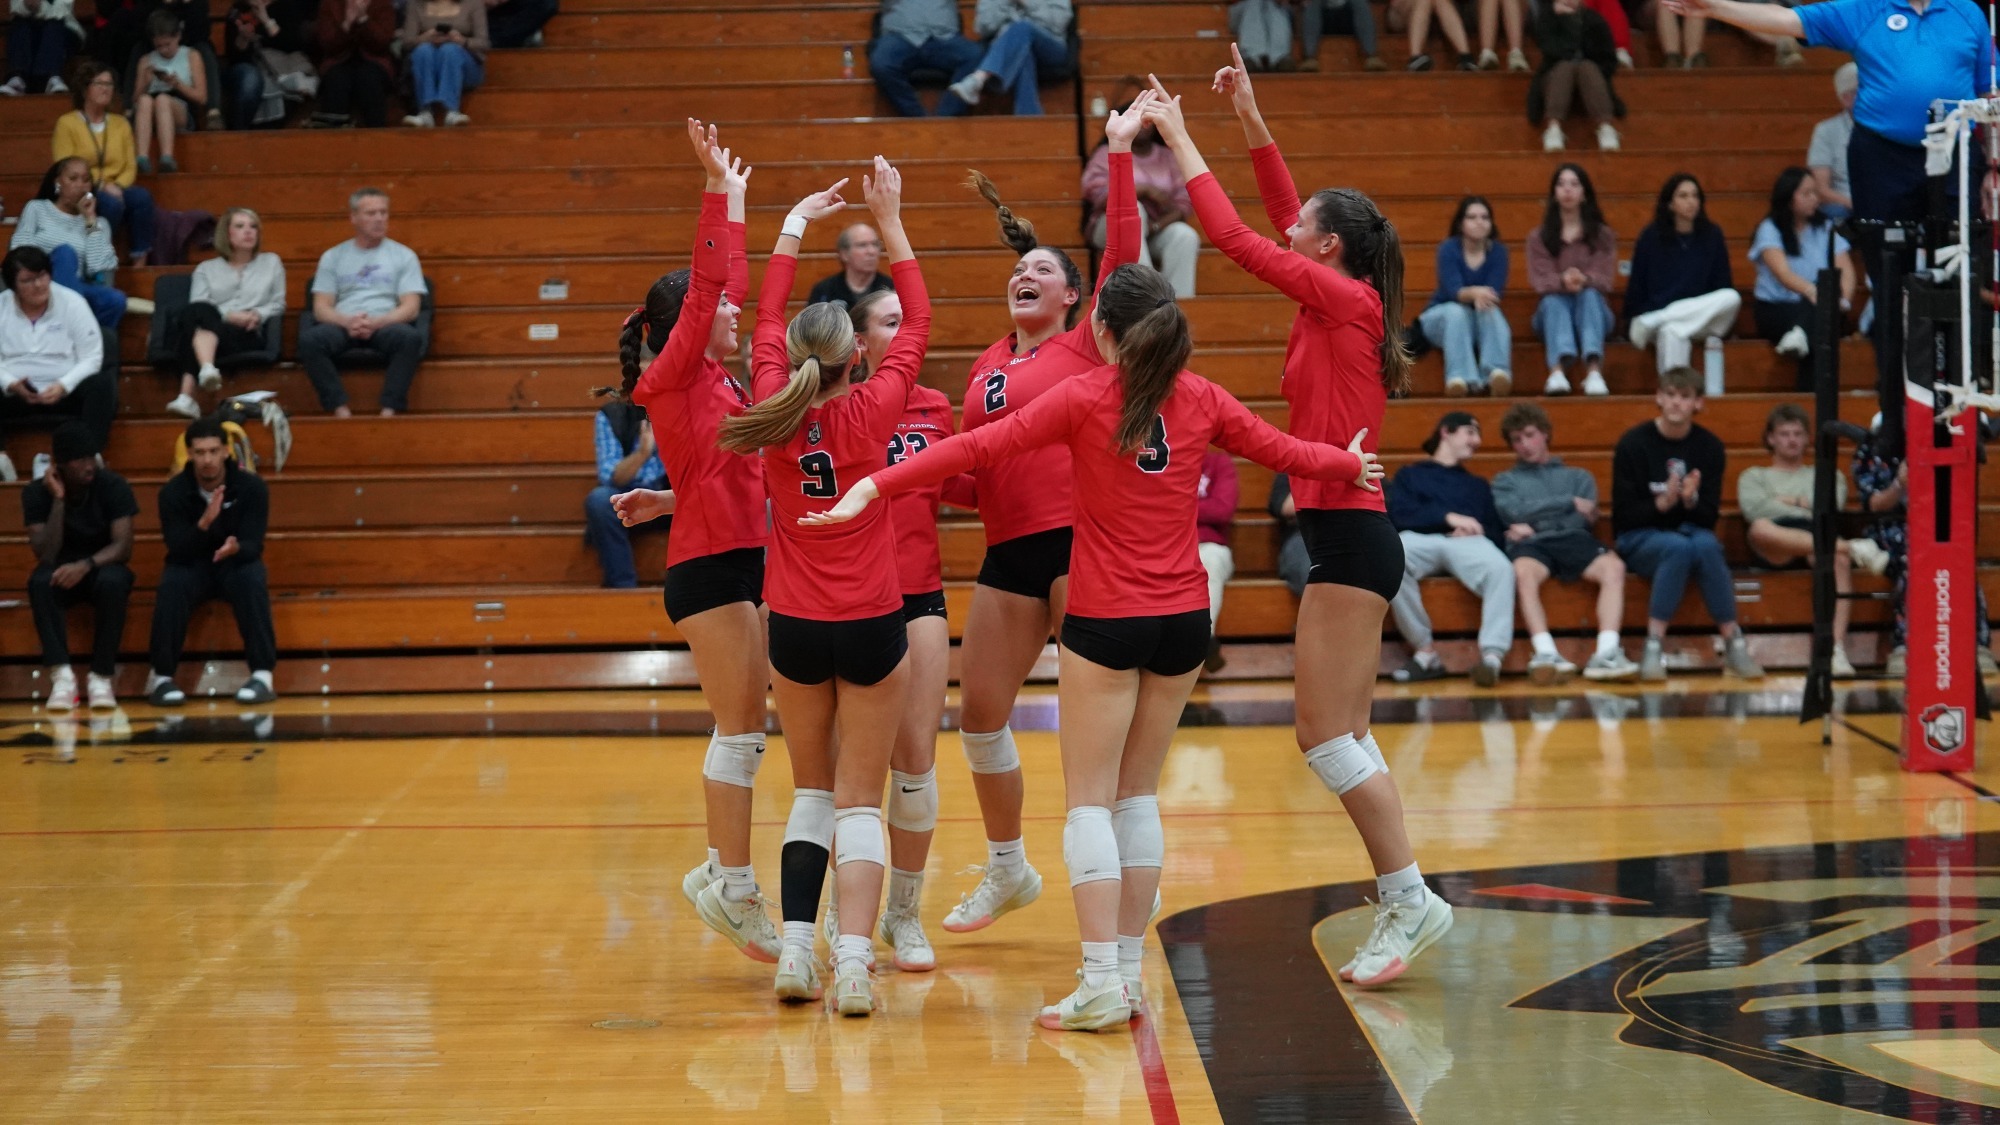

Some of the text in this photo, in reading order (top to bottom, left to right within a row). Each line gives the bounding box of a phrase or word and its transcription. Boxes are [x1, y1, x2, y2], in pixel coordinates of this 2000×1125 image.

[984, 372, 1007, 414] 2
[1136, 413, 1170, 473] 3
[798, 450, 838, 499] 9
[1933, 569, 1952, 690] sports imports
